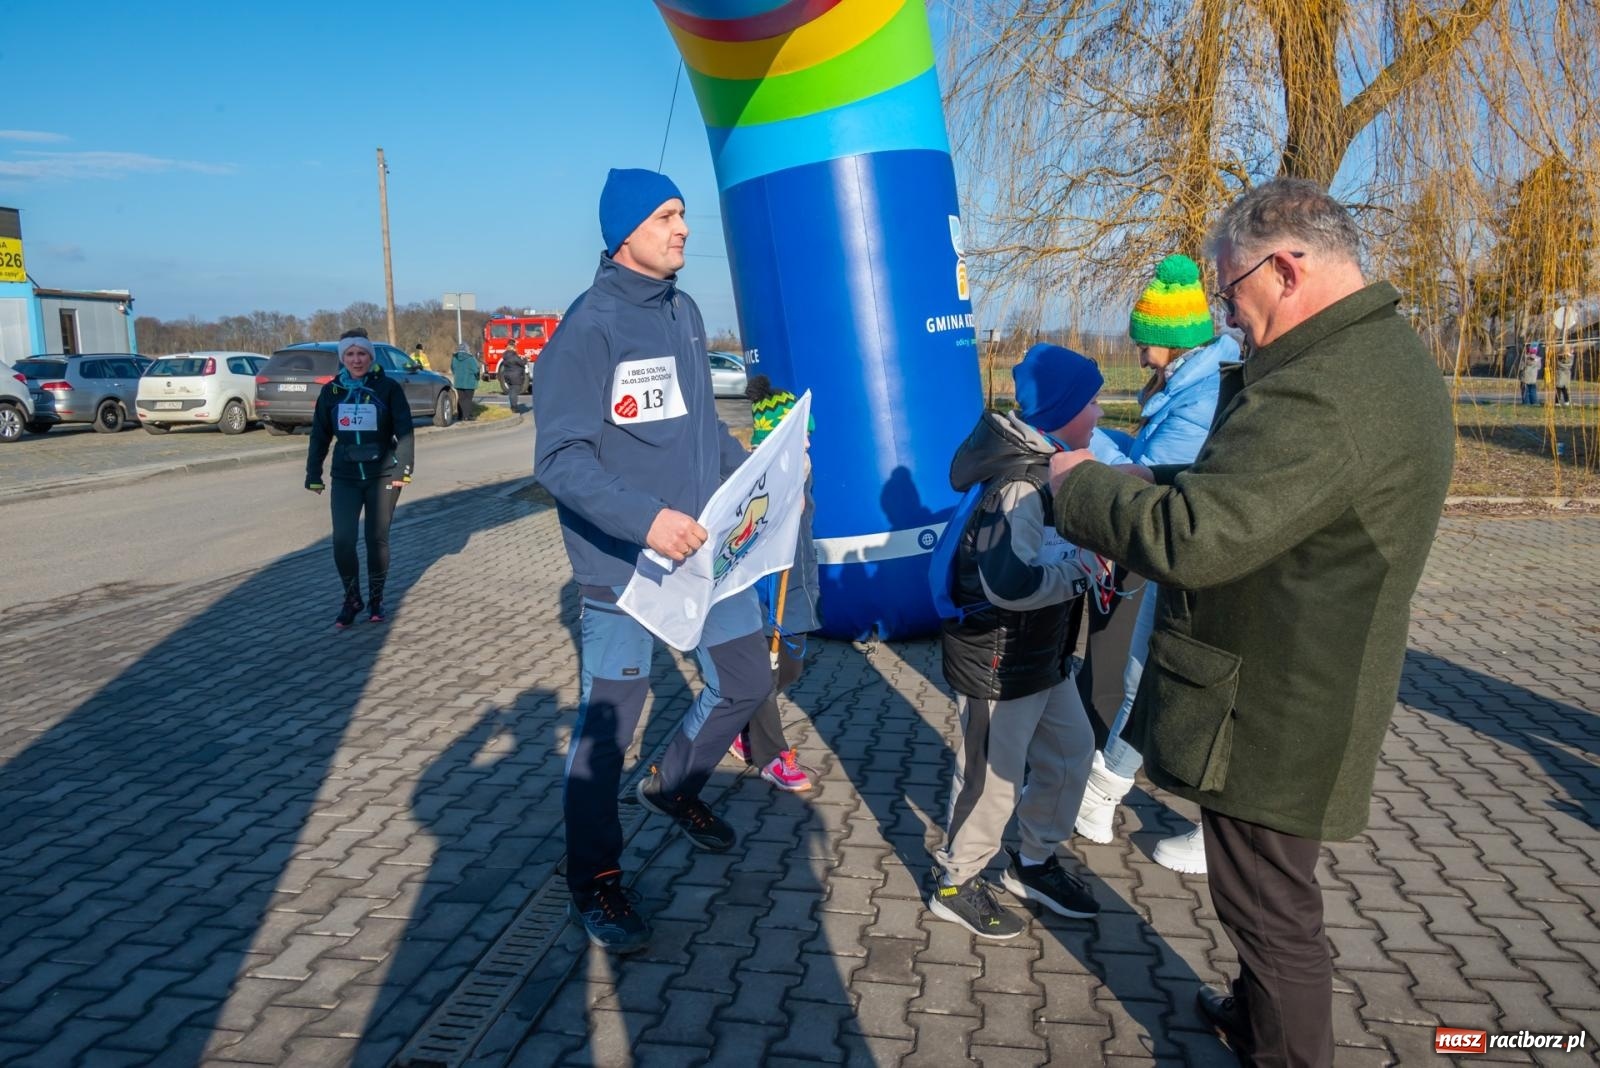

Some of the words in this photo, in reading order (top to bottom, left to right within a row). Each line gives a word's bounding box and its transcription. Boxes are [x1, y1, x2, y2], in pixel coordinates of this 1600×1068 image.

[926, 314, 964, 334] GMINA
[631, 368, 645, 376] BIEG
[643, 389, 664, 410] 13
[351, 416, 363, 425] 47
